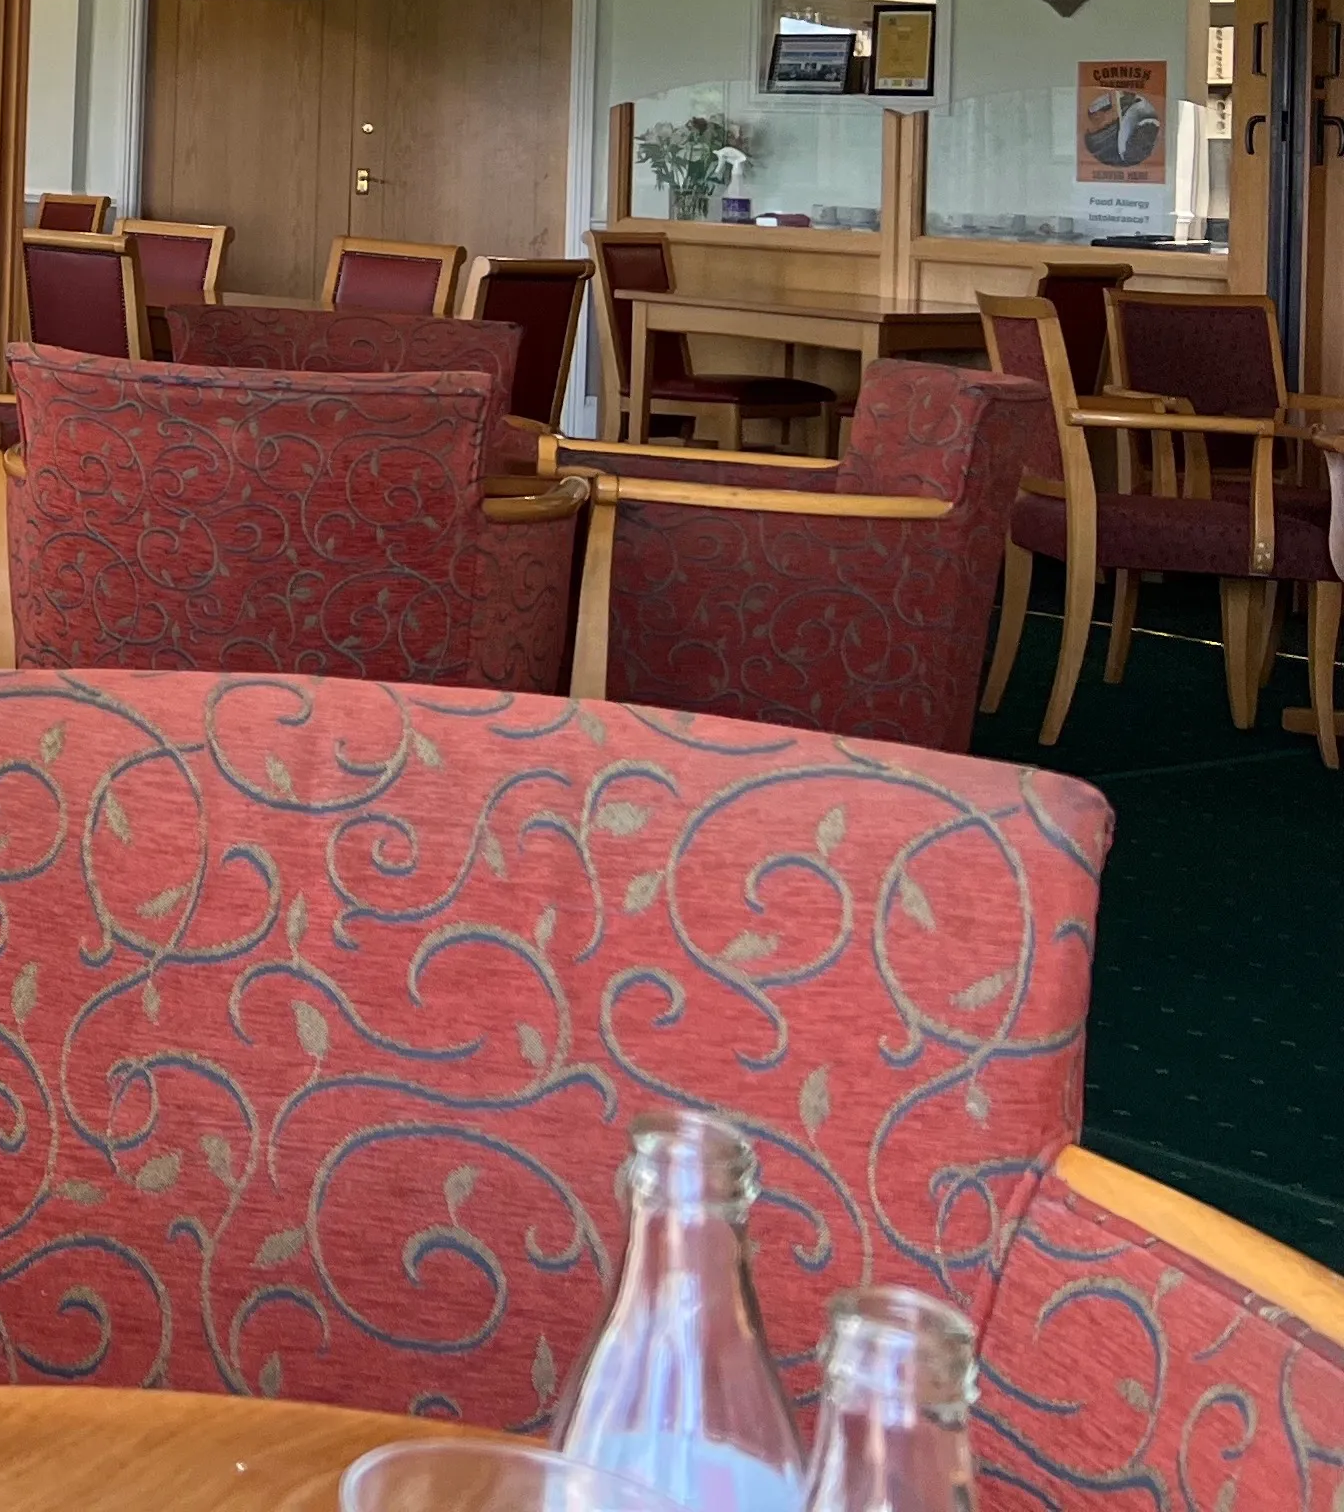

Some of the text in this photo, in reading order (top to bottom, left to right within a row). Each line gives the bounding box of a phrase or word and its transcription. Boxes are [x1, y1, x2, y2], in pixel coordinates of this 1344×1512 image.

[1092, 66, 1152, 81] CORNISH
[1089, 197, 1150, 210] Food Allergy
